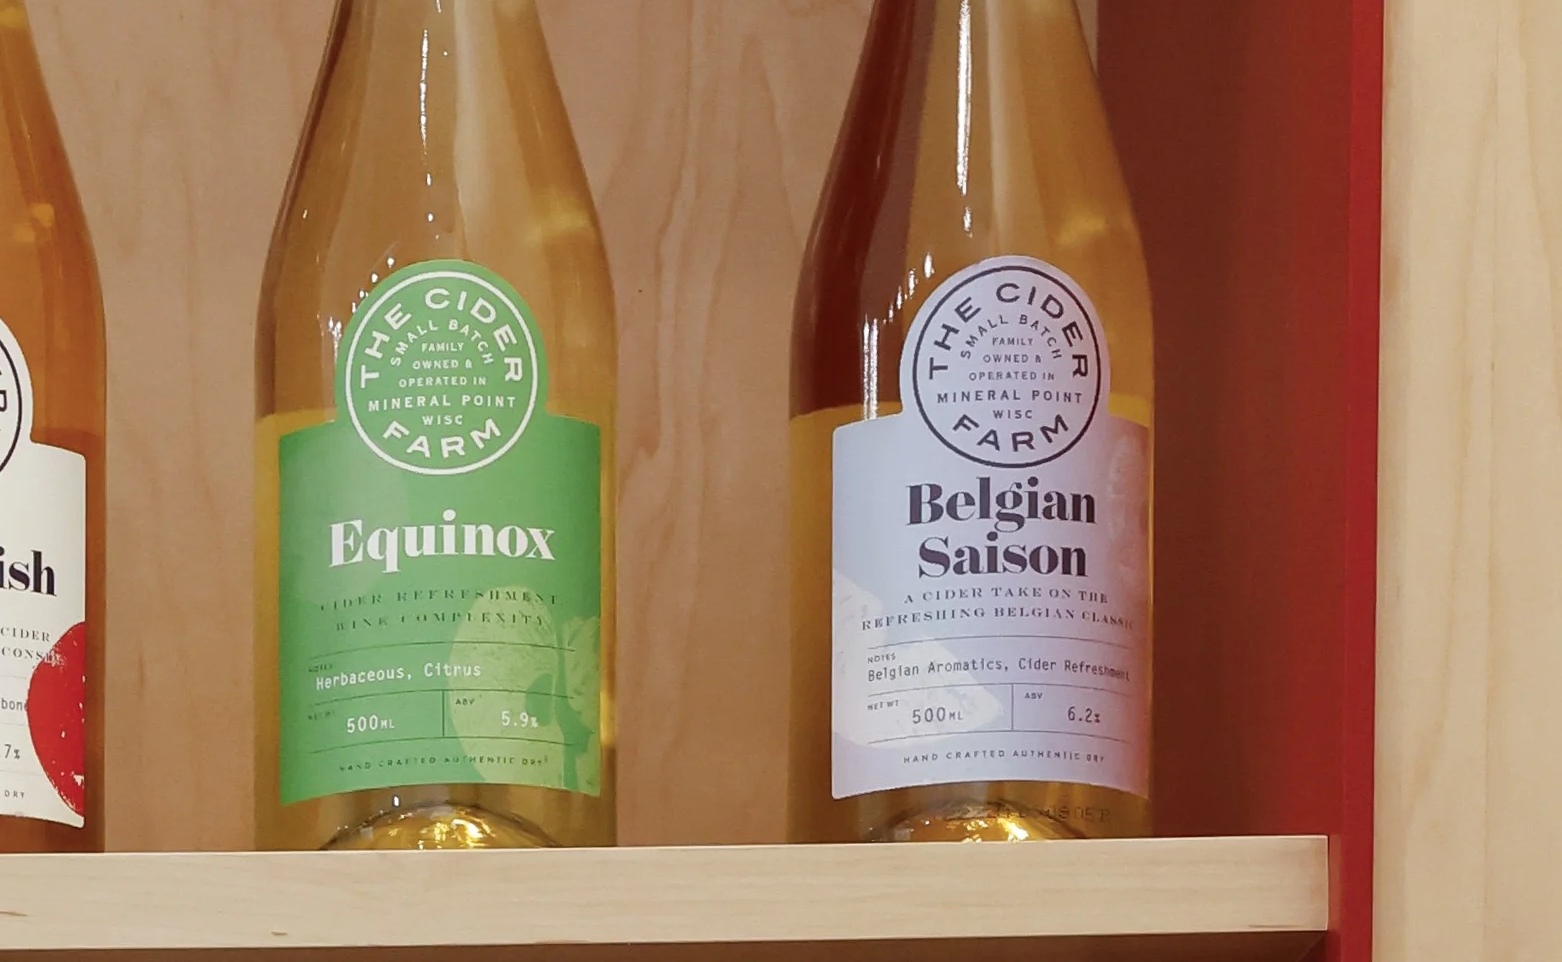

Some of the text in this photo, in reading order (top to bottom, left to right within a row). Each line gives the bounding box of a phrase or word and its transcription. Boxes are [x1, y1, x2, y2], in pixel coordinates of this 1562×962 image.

[360, 288, 523, 389] THE CIDER
[390, 318, 494, 367] SMALL BATCH
[929, 283, 1088, 379] THE CIDER
[960, 314, 1062, 359] SMALL BATCH
[368, 395, 516, 411] MINERAL POINT
[937, 389, 1083, 404] MINERAL POINT
[383, 418, 501, 458] FARM
[953, 414, 1069, 452] FARM
[905, 476, 1096, 532] Belgian
[329, 509, 555, 574] Equinox
[918, 531, 1087, 578] Saison
[904, 587, 1108, 604] A CIDER TAKE ON THE
[862, 608, 986, 630] REFRESHING
[994, 607, 1075, 620] BELGIAN
[0, 627, 50, 642] CIDER
[316, 666, 412, 690] Herbaceous,
[424, 663, 481, 677] Citrus
[868, 665, 919, 682] Belgian
[928, 657, 1009, 673] Aromatics,
[1018, 658, 1056, 671] Cider
[501, 711, 538, 728] 5.9%
[1067, 706, 1101, 723] 6.2%
[4, 790, 25, 798] DRY
